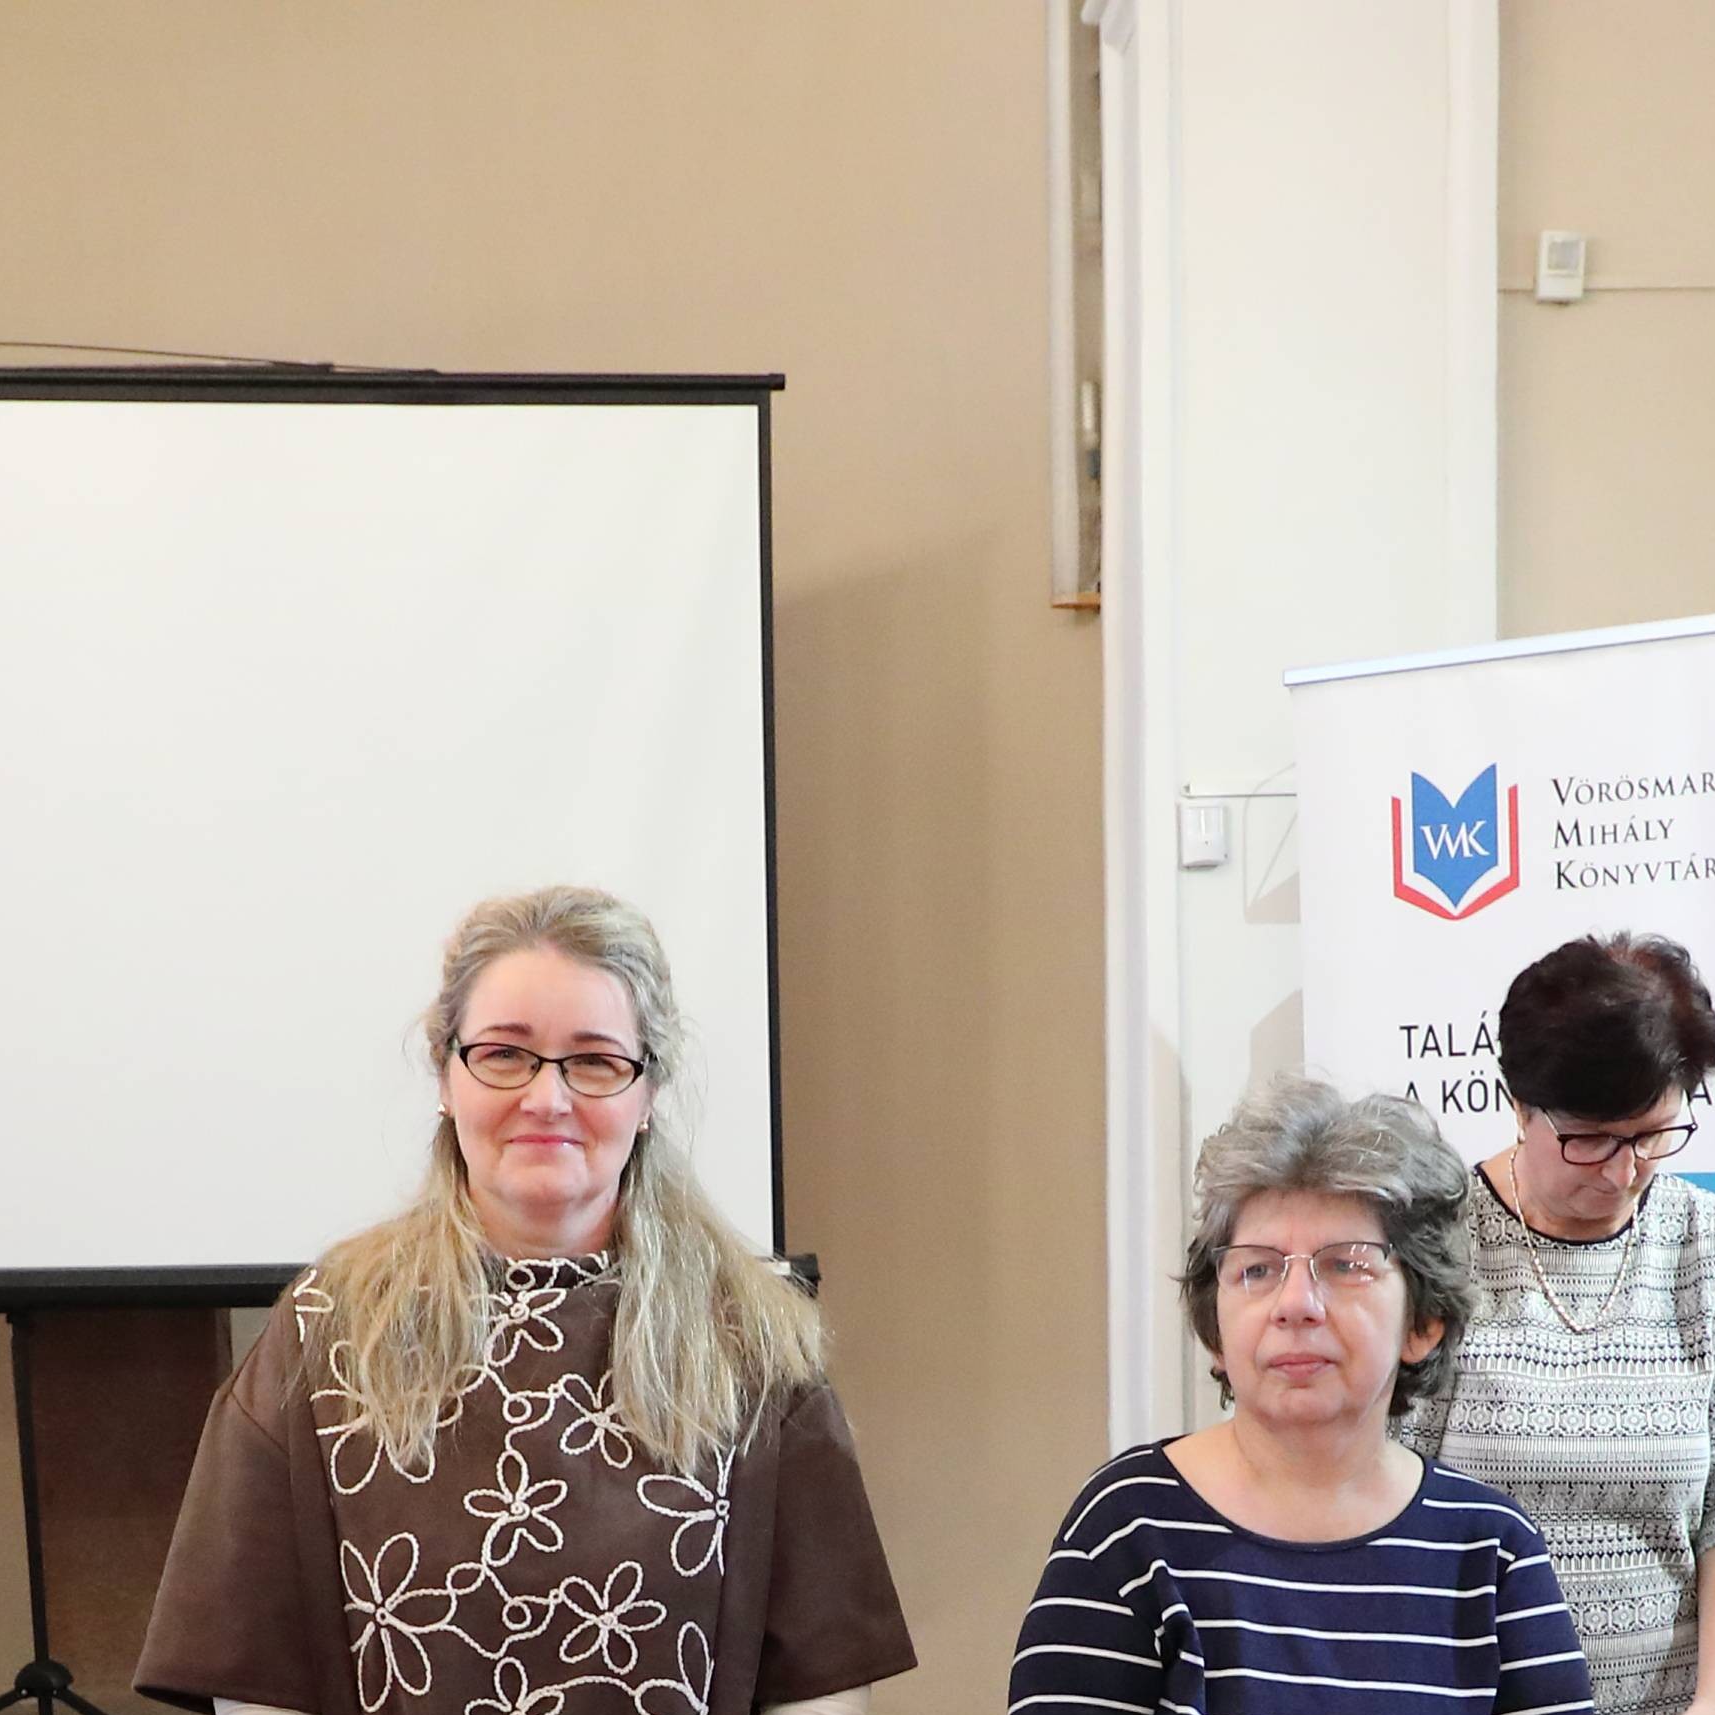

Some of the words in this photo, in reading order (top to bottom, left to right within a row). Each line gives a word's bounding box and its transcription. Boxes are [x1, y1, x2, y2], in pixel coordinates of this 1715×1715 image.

[1420, 820, 1490, 861] VMK
[1553, 815, 1675, 849] MIHÁLY
[1400, 1011, 1498, 1058] TALÁ
[1441, 1070, 1513, 1113] KÖN
